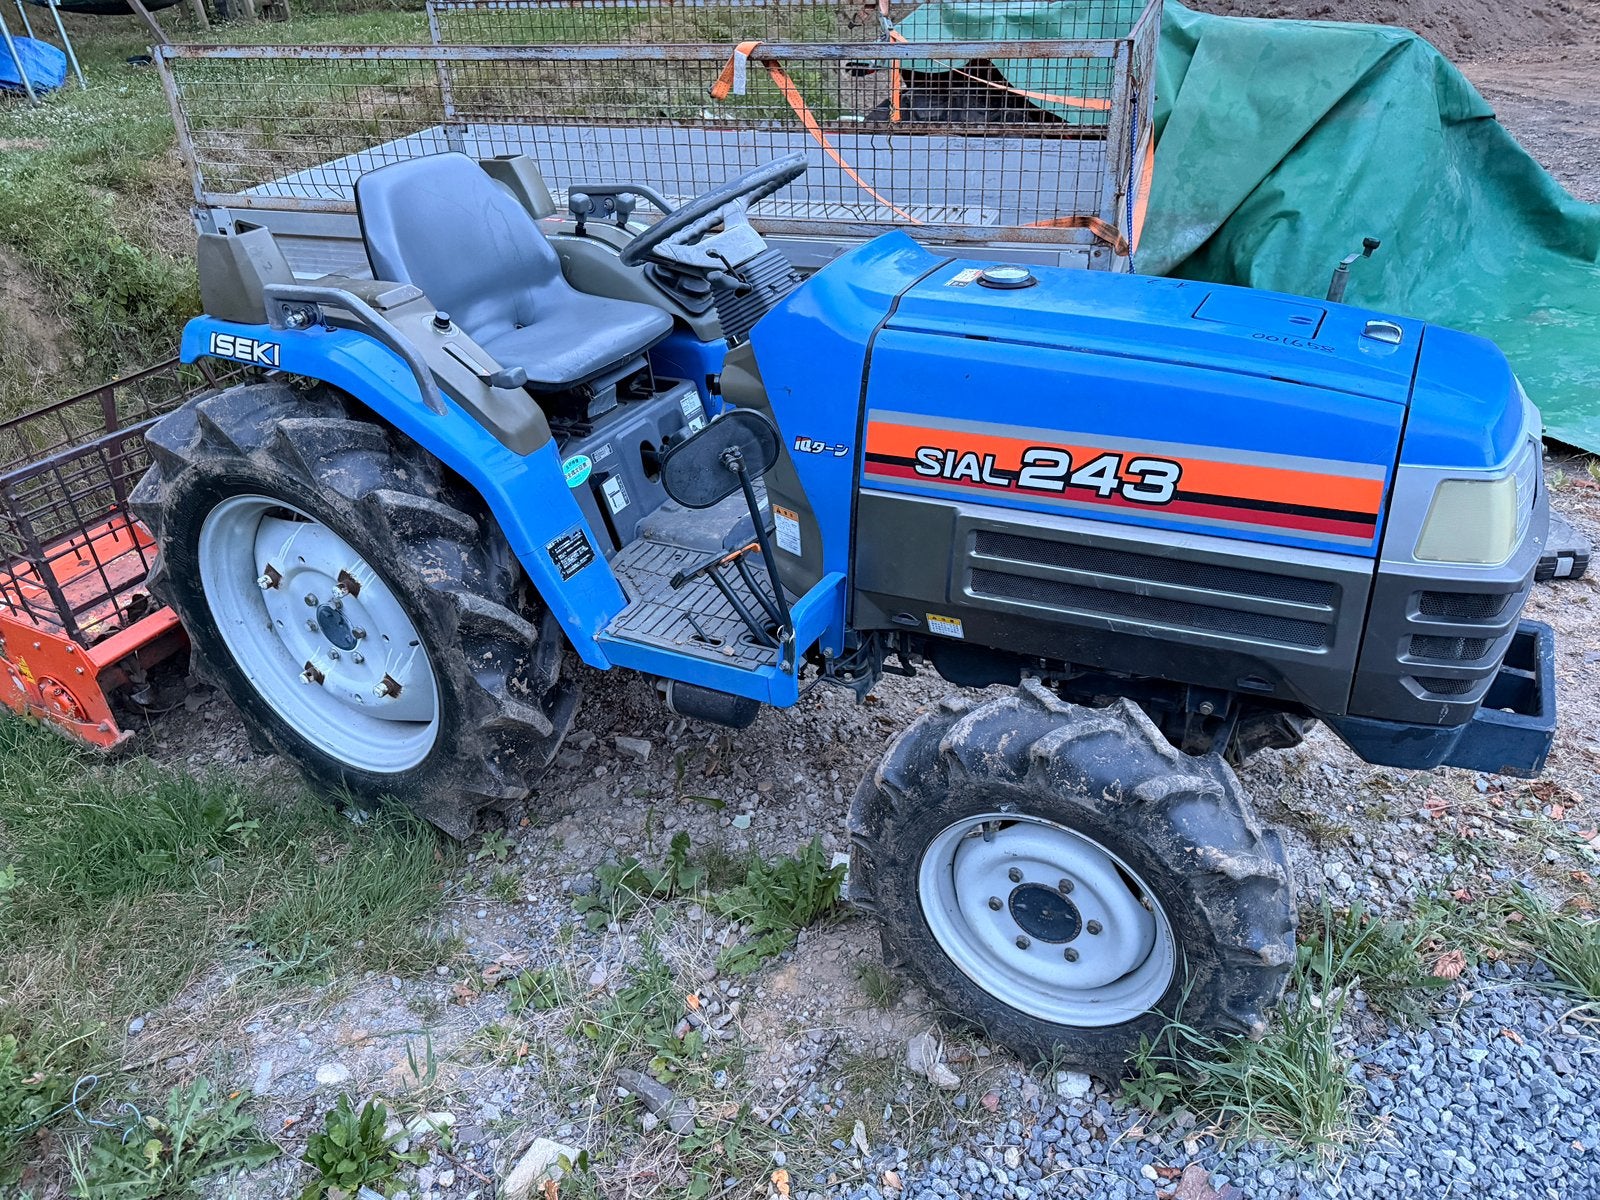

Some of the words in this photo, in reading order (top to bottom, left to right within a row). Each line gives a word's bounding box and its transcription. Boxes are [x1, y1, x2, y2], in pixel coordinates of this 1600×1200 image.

[209, 331, 281, 367] ISEKI
[914, 446, 1012, 487] SIAL
[1016, 447, 1183, 505] 243
